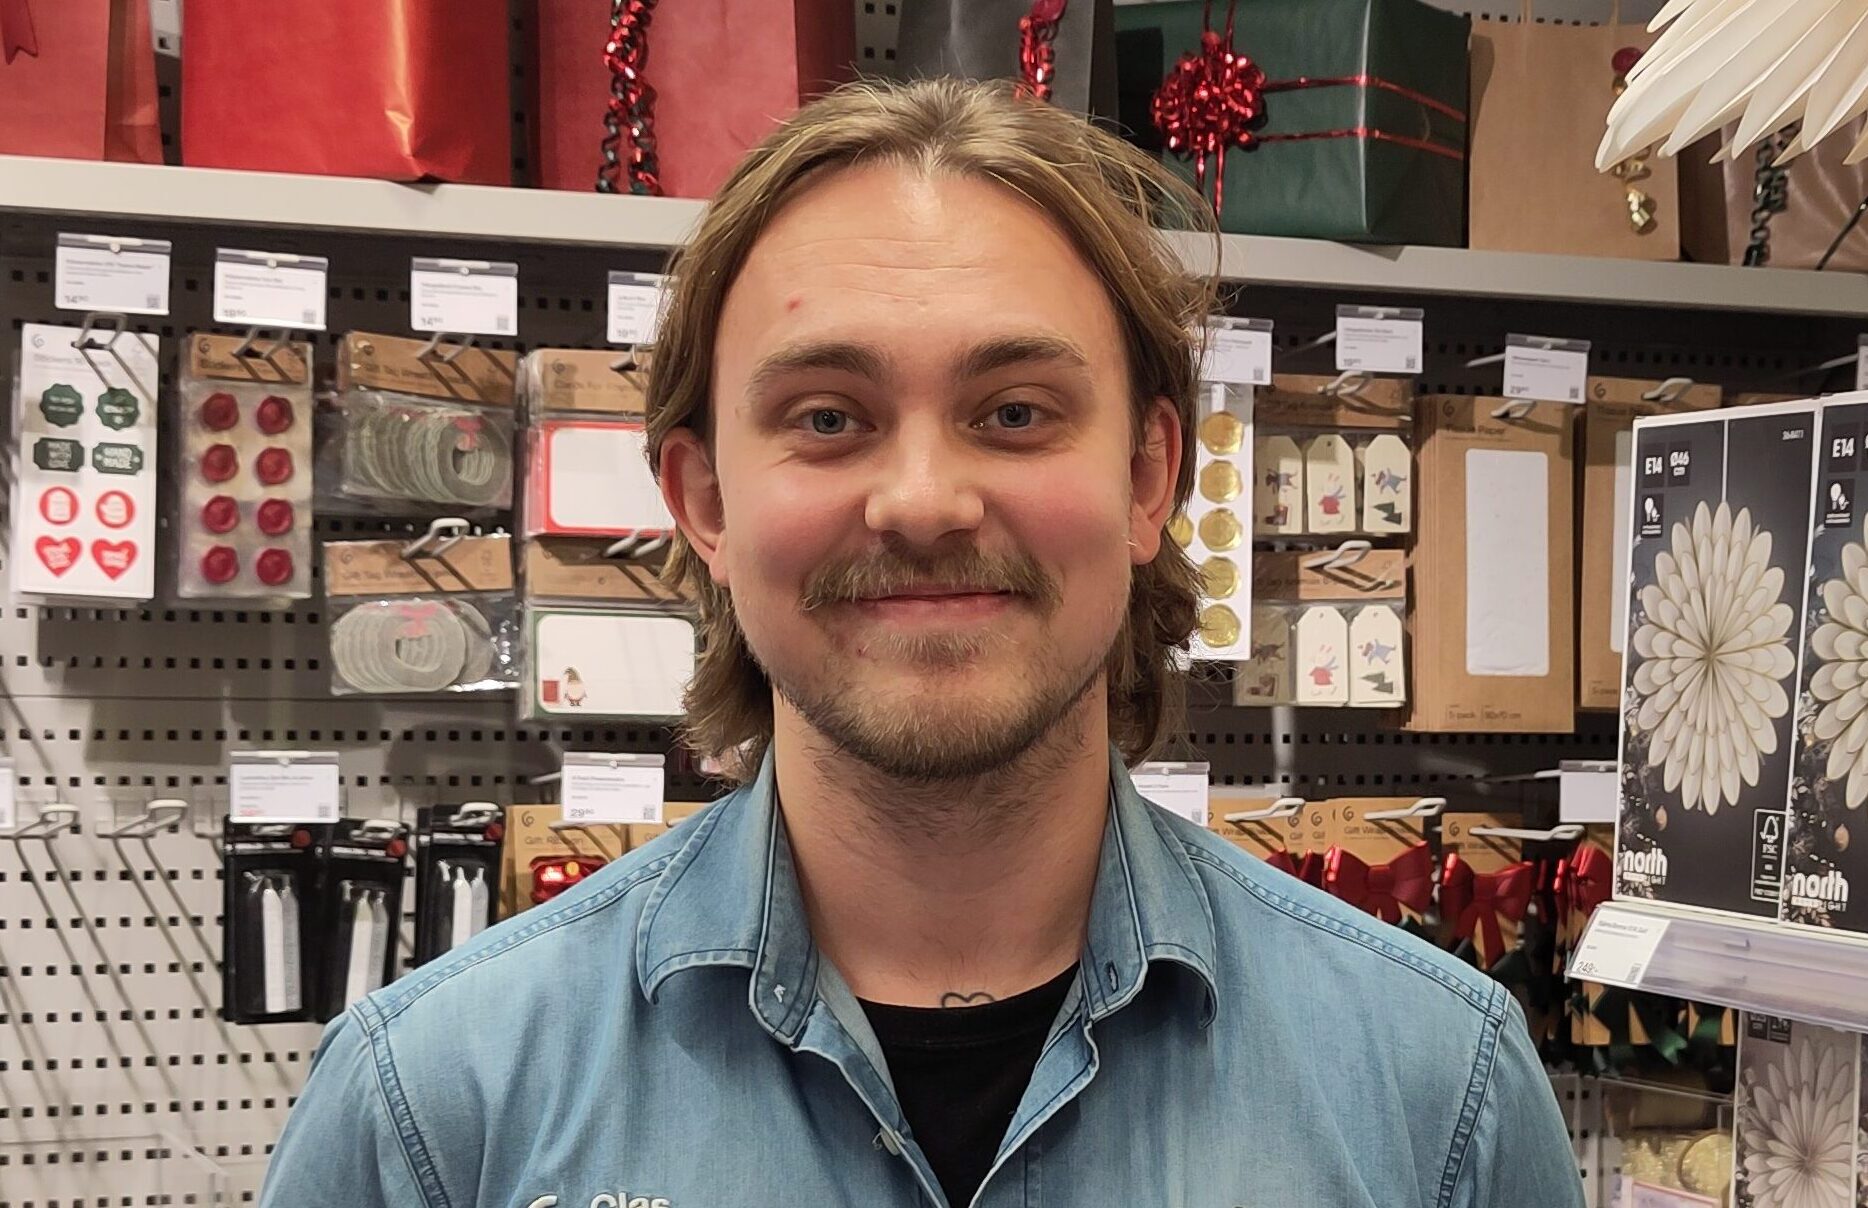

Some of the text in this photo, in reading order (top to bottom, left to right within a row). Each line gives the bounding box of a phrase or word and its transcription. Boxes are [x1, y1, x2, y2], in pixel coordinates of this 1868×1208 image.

[1832, 437, 1855, 458] E14
[1645, 456, 1663, 475] E14
[1623, 847, 1668, 877] north
[1791, 870, 1849, 902] north
